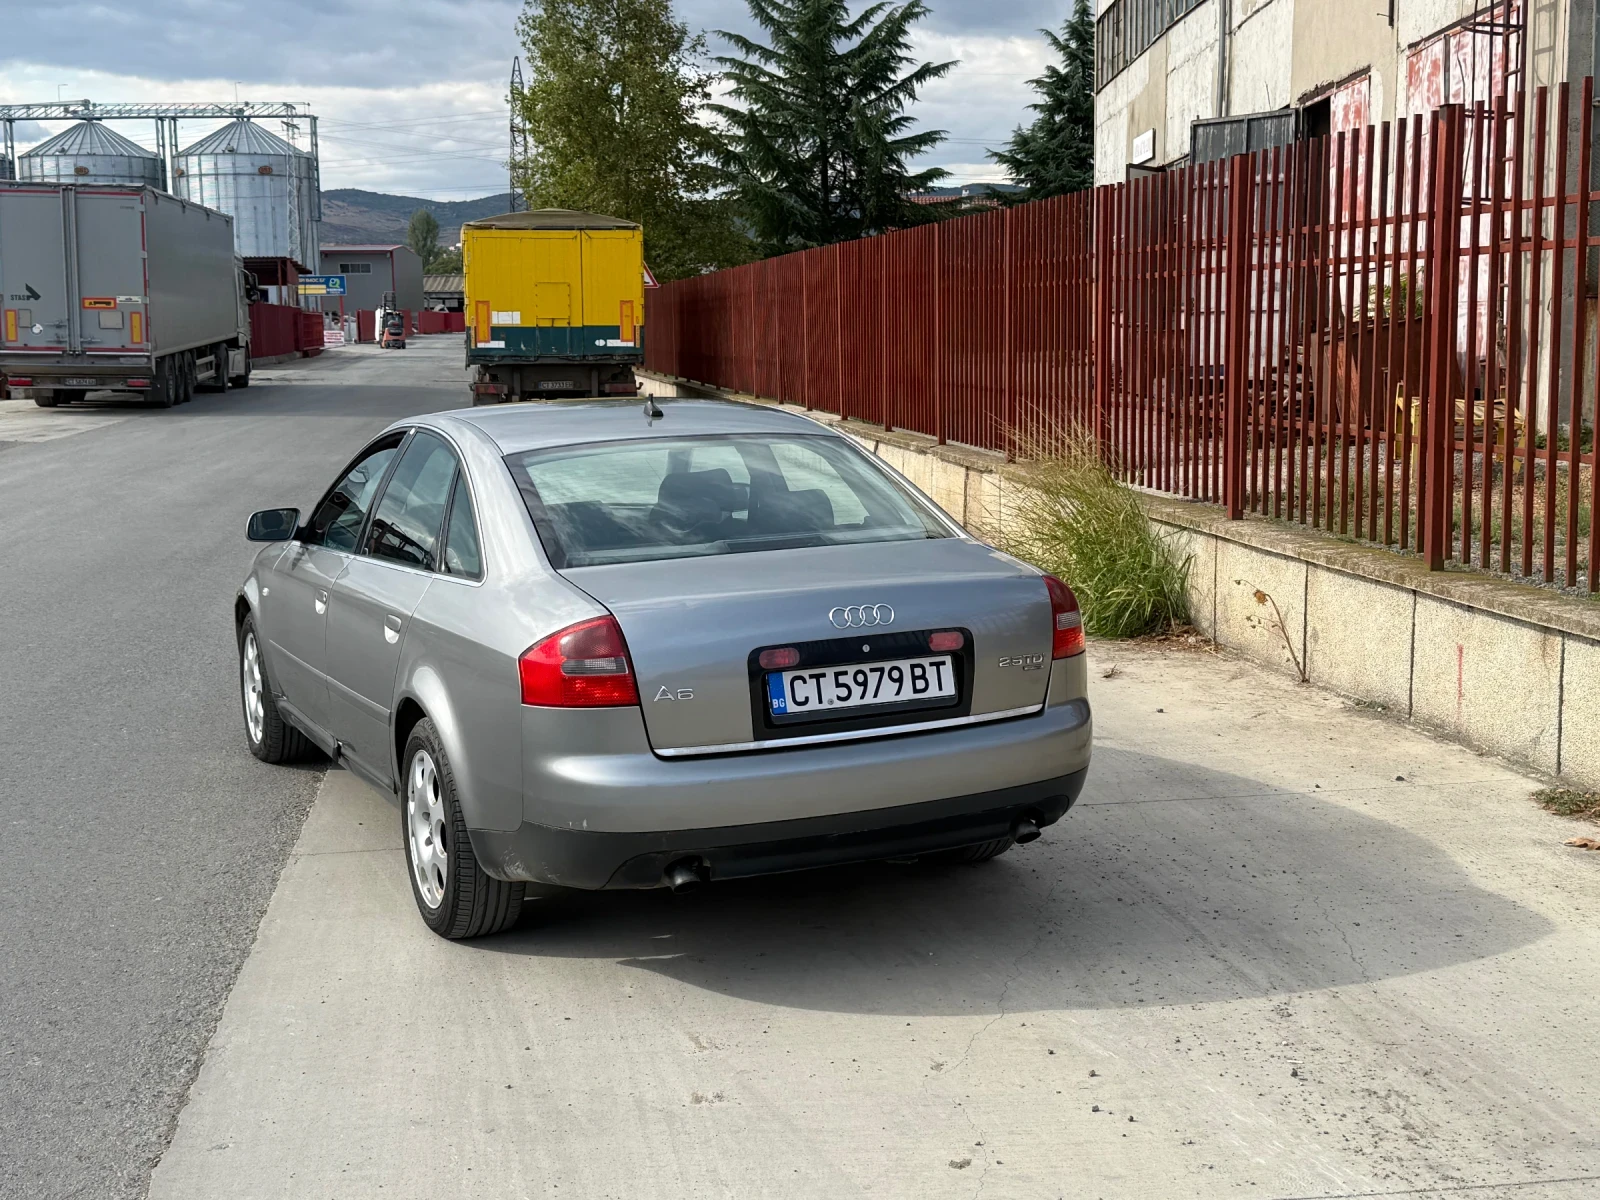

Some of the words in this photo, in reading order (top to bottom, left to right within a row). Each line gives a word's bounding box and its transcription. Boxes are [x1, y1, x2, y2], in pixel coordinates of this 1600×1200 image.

[833, 665, 904, 702] 5979
[909, 660, 947, 695] BT
[653, 685, 694, 702] A6
[772, 698, 786, 709] BG
